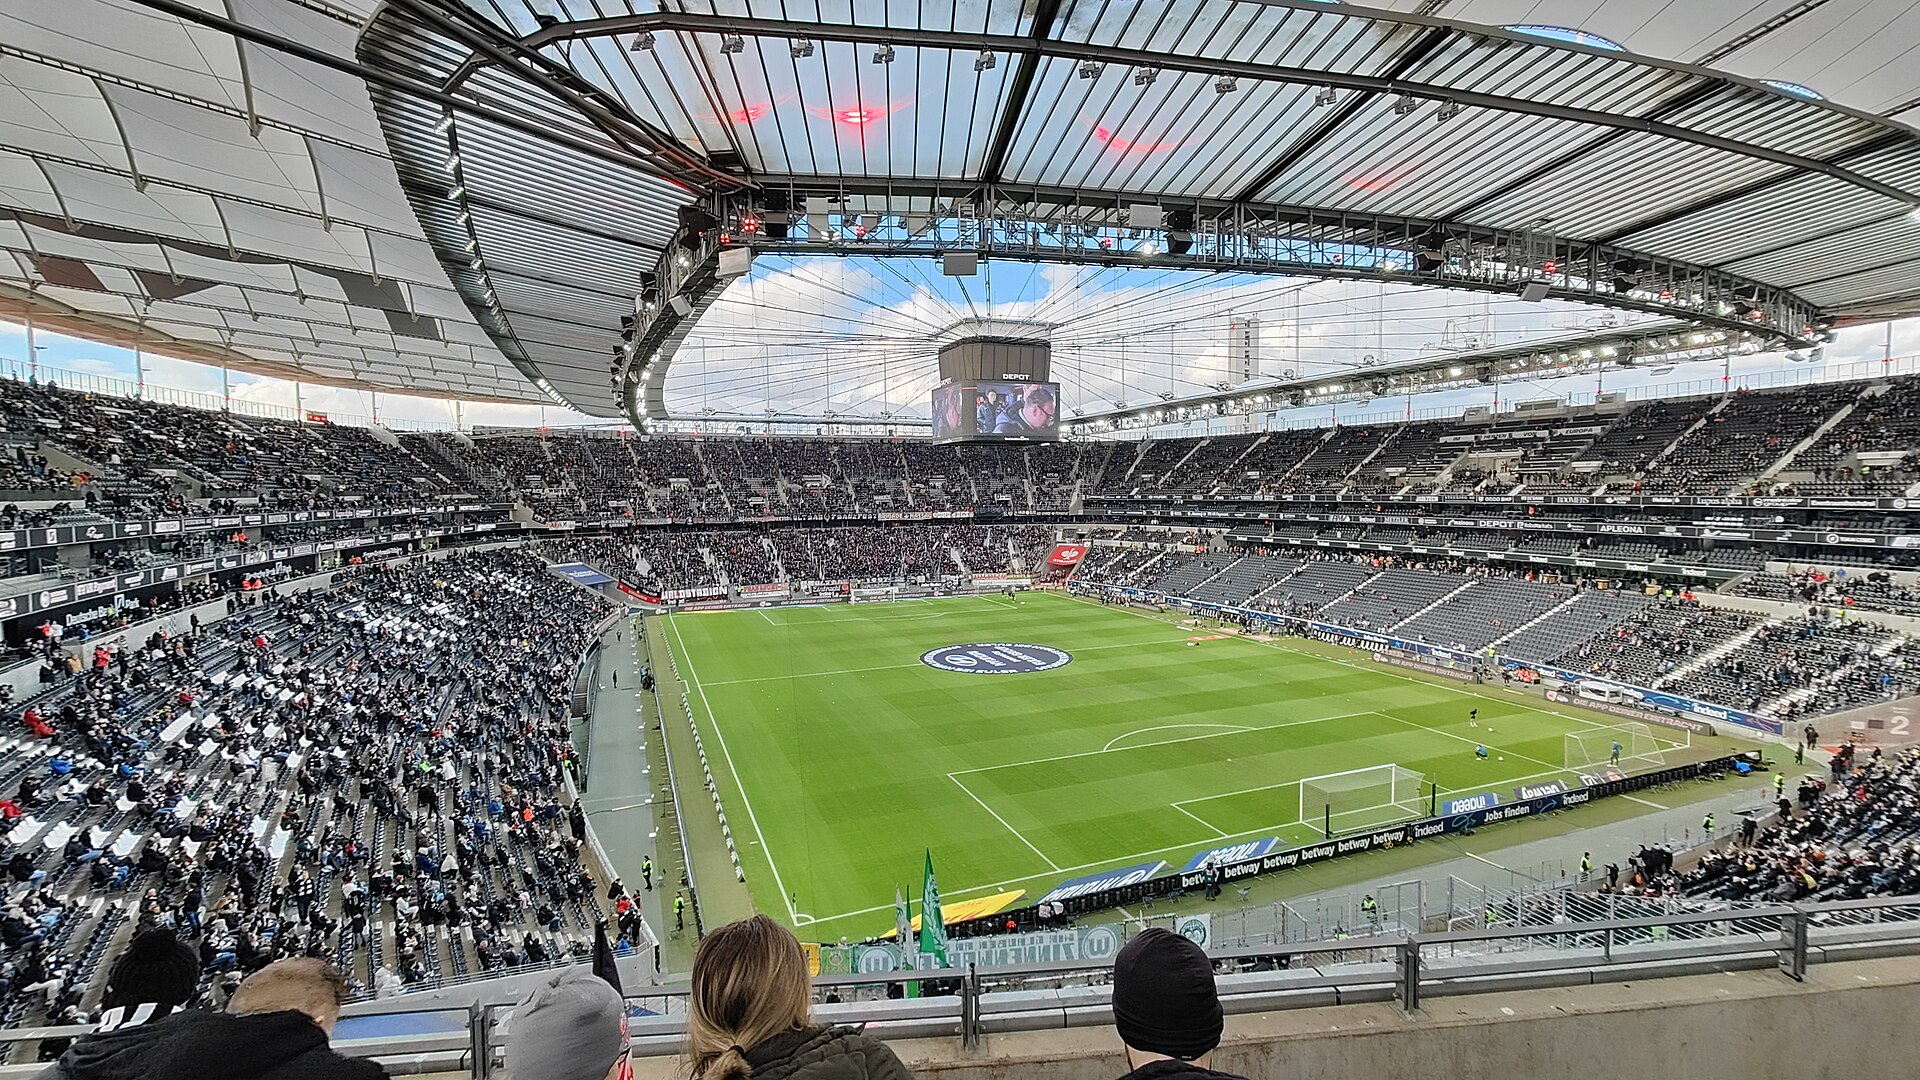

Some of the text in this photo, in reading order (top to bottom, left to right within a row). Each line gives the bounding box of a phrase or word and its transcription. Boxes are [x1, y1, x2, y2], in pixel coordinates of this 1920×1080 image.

[1002, 373, 1031, 381] DEPOT
[1565, 427, 1594, 435] EUROPA
[1479, 520, 1515, 528] DEPOT
[1600, 525, 1643, 534] APLEONA
[660, 585, 728, 600] WALDSTADION
[66, 608, 98, 626] Deutsche
[1573, 698, 1704, 732] DIE APP DEINER EINTRACHT
[1692, 702, 1728, 720] indeed
[1890, 716, 1910, 735] 2
[1562, 791, 1589, 806] indeed
[1484, 804, 1530, 824] Jobs finden
[1414, 820, 1444, 838] indeed
[1224, 861, 1260, 878] betway
[1263, 852, 1298, 869] betway
[1301, 844, 1335, 861] betway
[1338, 837, 1371, 853] betway
[1373, 830, 1405, 846] betway
